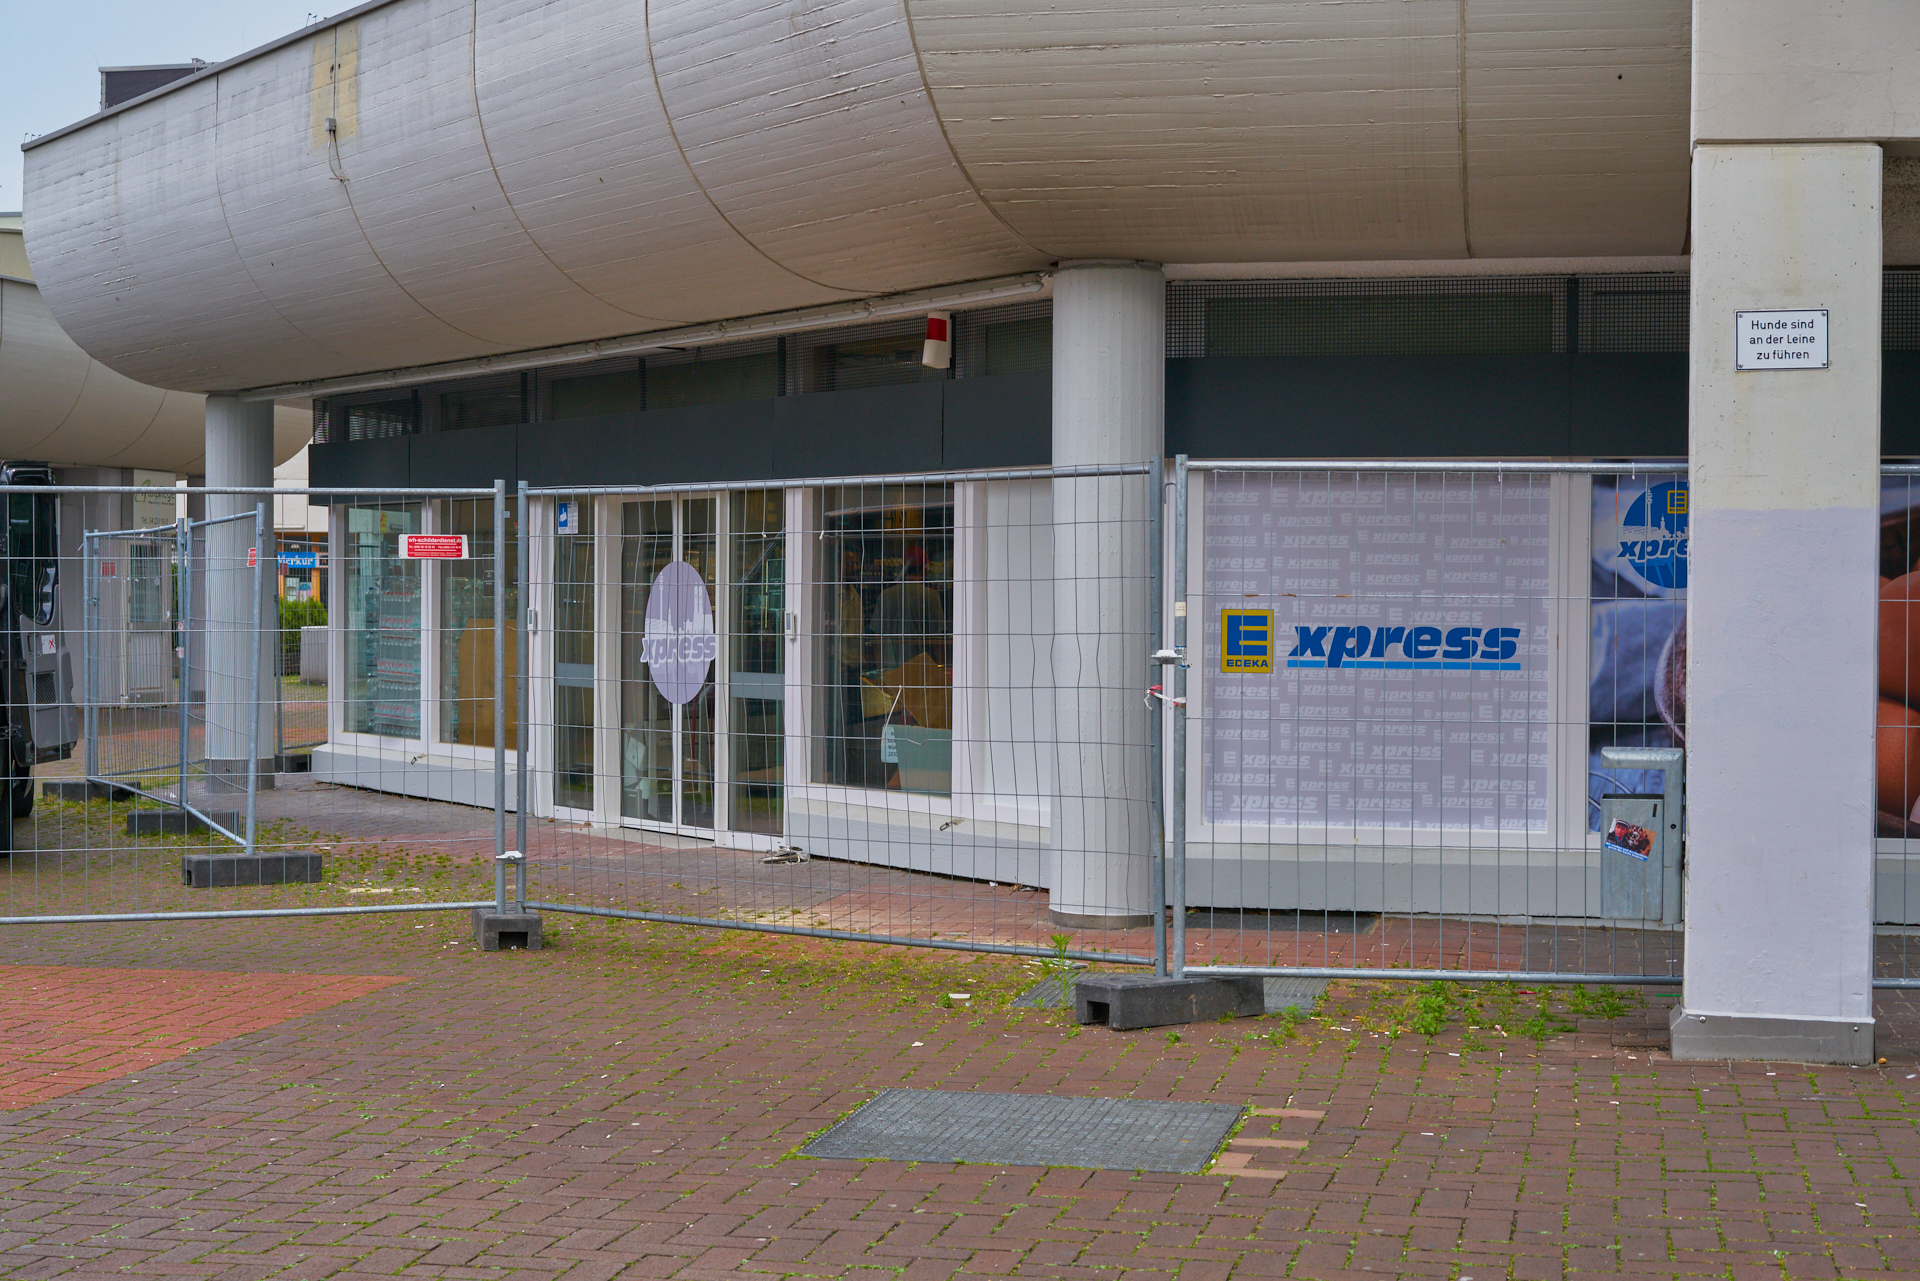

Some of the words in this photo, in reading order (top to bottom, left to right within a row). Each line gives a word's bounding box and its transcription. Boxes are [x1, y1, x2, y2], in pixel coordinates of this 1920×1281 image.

[1751, 320, 1788, 330] Hunde
[1790, 319, 1814, 329] sind
[1750, 336, 1763, 344] an
[1766, 334, 1784, 344] der
[1787, 334, 1815, 344] Leine
[1772, 350, 1810, 360] führen
[1206, 558, 1266, 571] press
[1227, 615, 1268, 656] E
[1288, 626, 1521, 668] xpress
[641, 636, 716, 665] xpress
[1226, 659, 1268, 668] EDEKA
